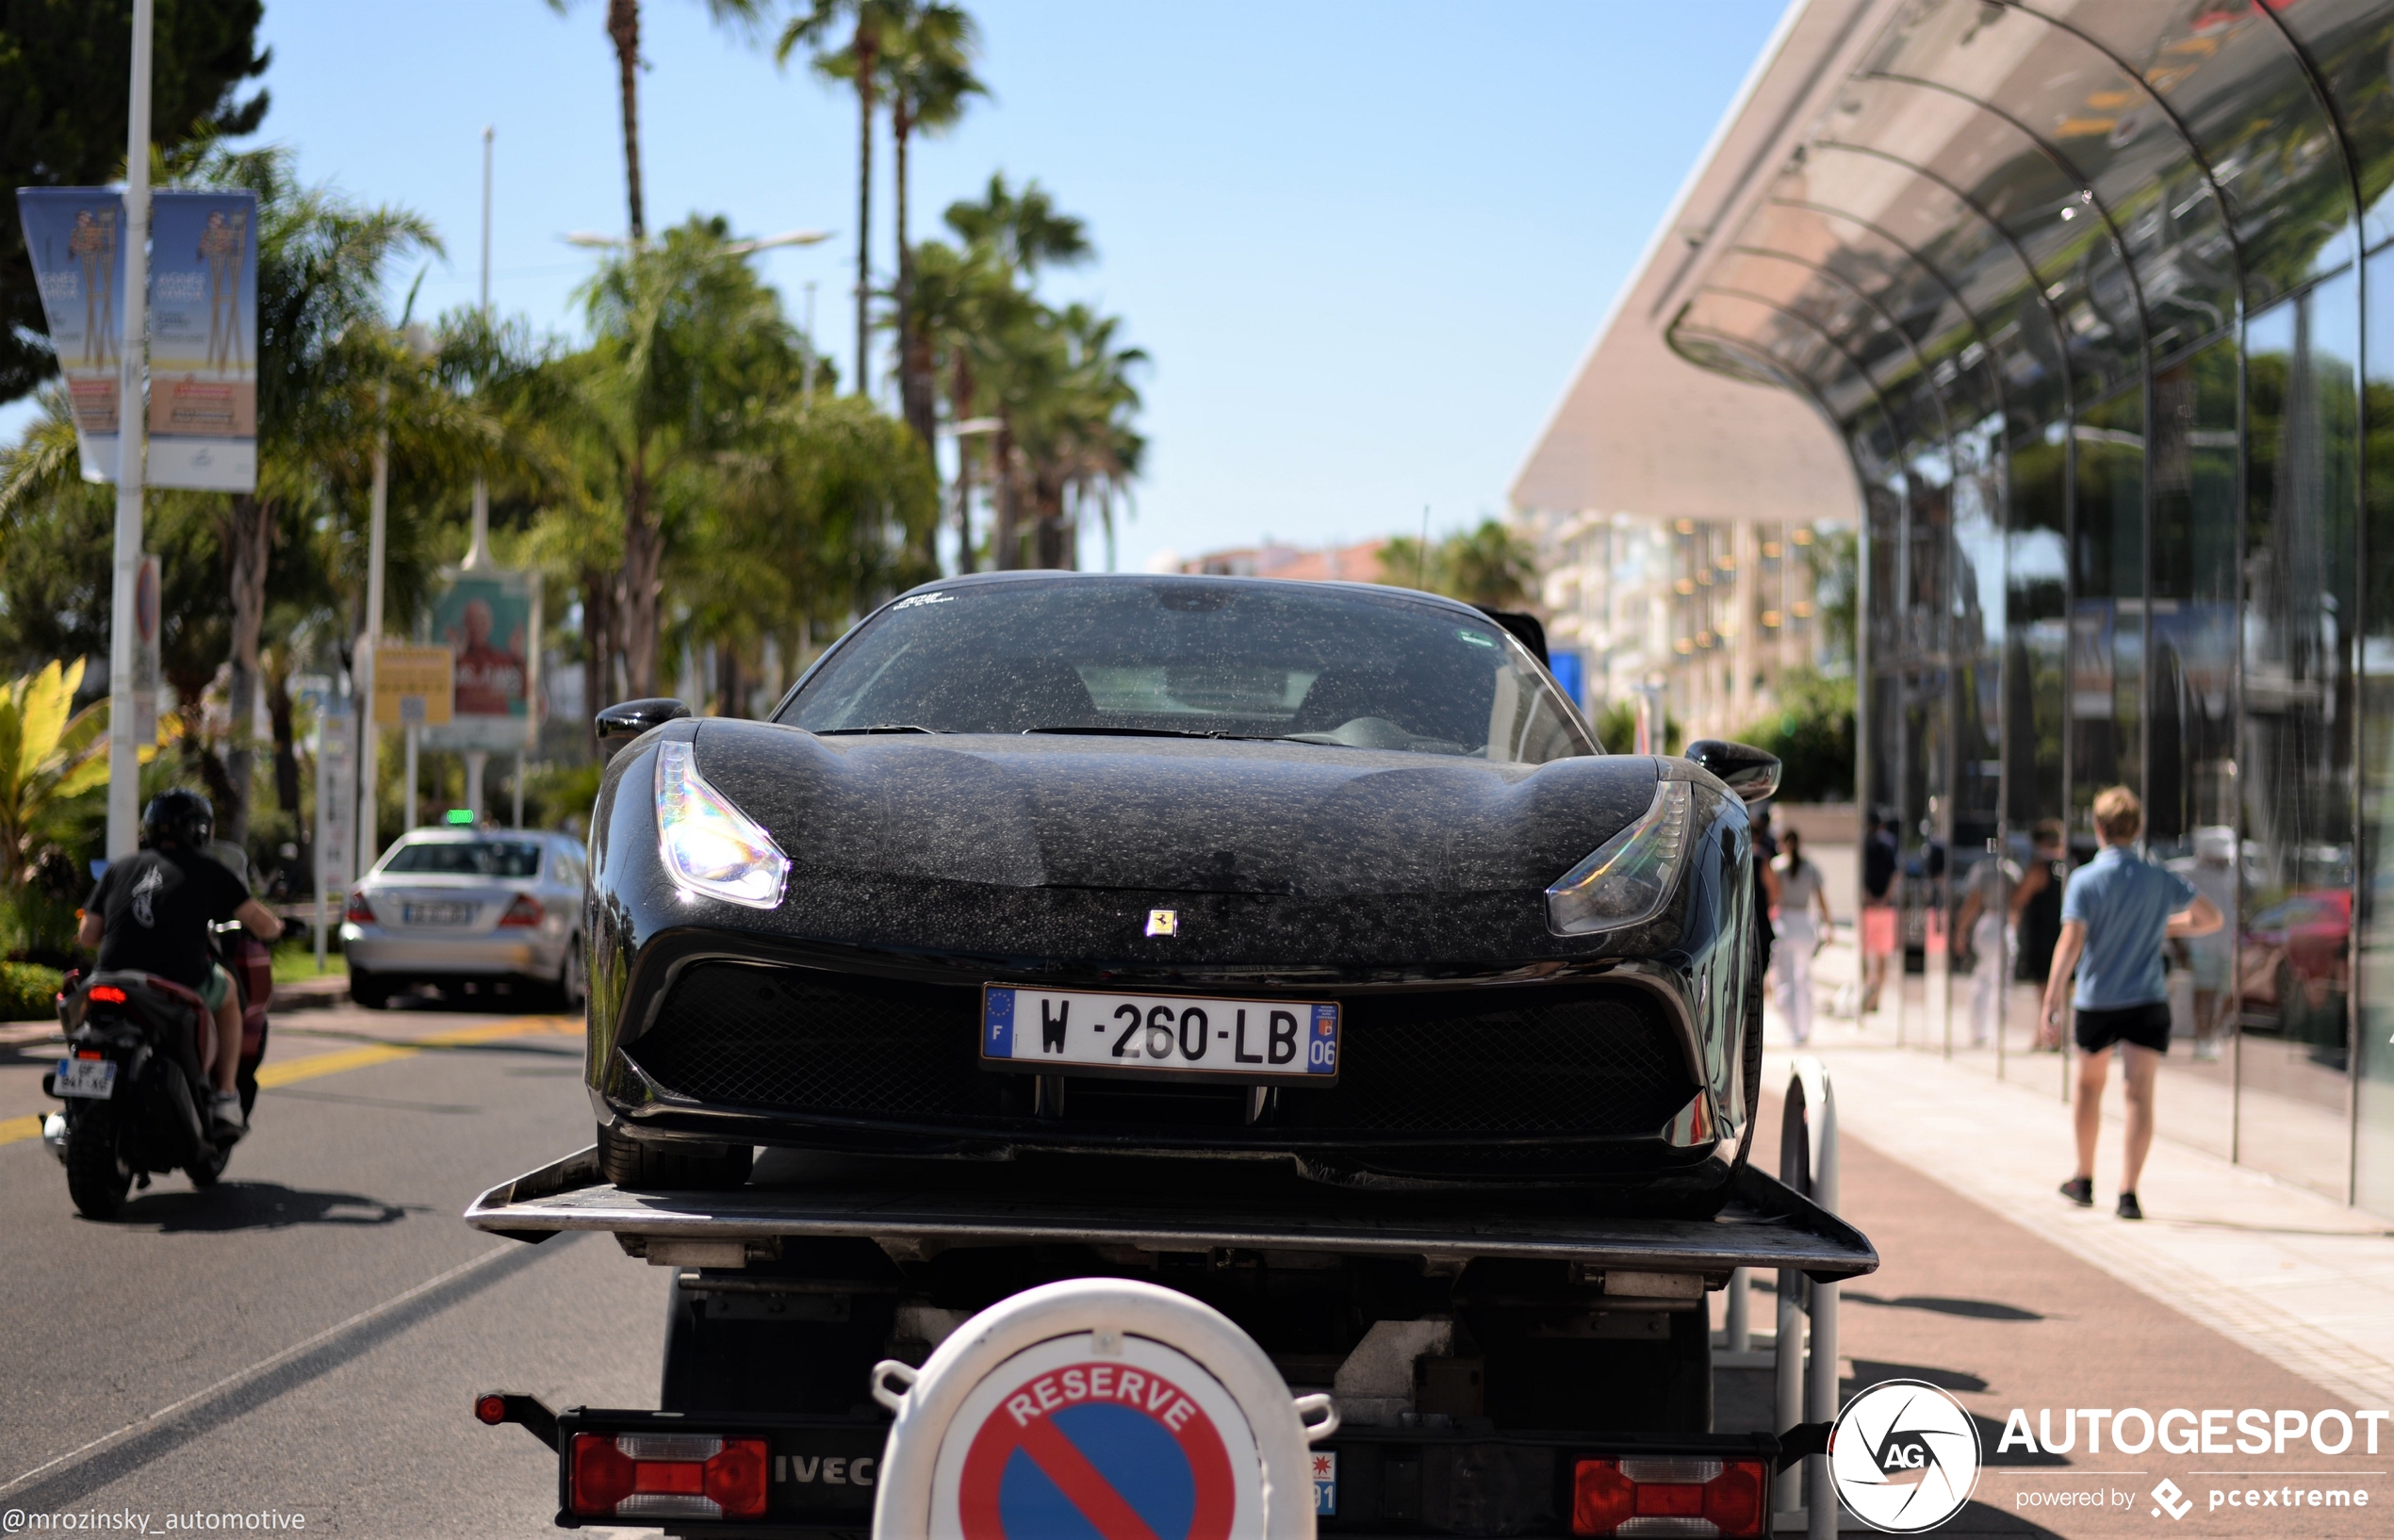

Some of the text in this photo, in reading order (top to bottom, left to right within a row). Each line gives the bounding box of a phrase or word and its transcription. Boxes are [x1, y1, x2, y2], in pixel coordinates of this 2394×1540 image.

[992, 1024, 1003, 1040] F
[1311, 1040, 1336, 1066] 06
[1006, 1367, 1197, 1432] RESERVE
[775, 1454, 884, 1486] IVEC
